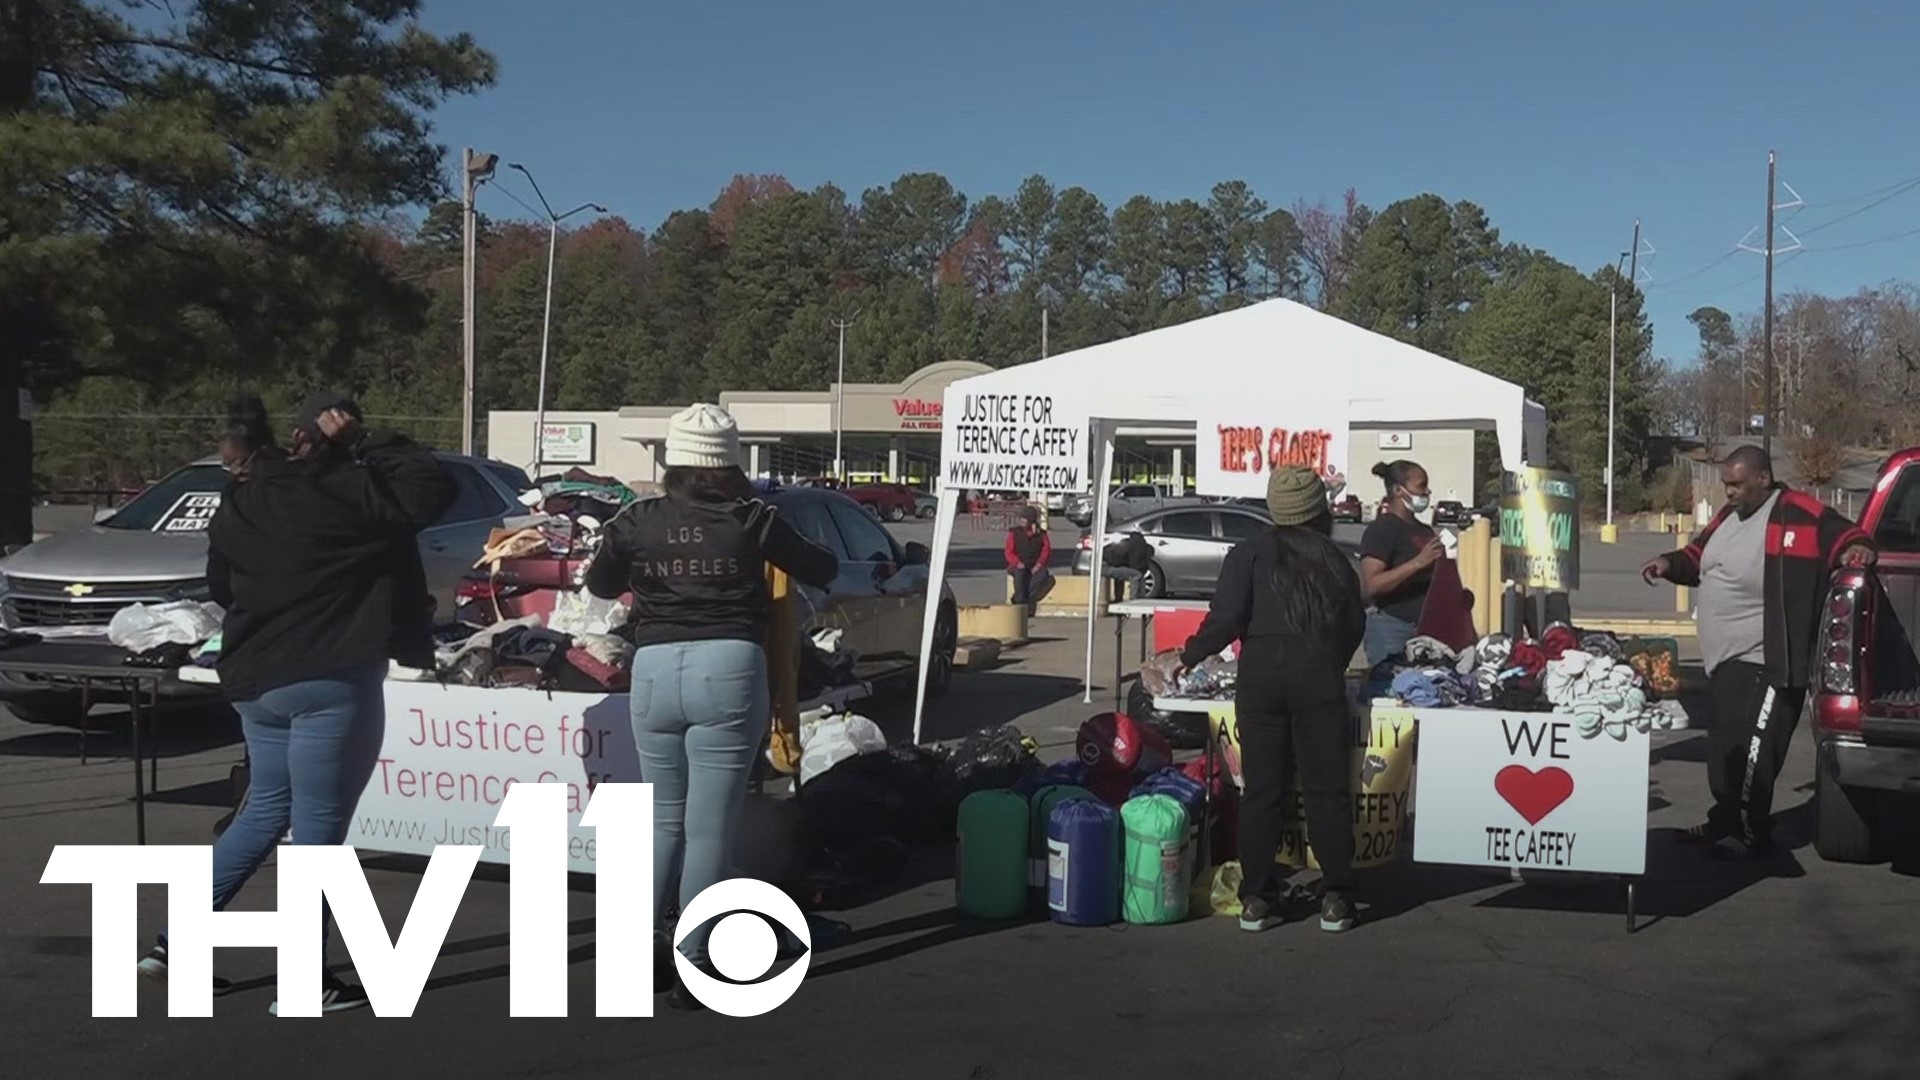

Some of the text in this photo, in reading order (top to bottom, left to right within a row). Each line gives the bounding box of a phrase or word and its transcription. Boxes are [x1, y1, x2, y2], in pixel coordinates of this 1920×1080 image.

[892, 399, 943, 416] Value
[961, 394, 1052, 424] JUSTICE FOR
[956, 425, 1078, 456] TERENCE CAFFEY
[949, 460, 1078, 490] WWW.JUSTICE4TEE.COM
[667, 527, 703, 544] LOS
[643, 558, 738, 577] ANGELES
[408, 707, 612, 760] Justice for
[1501, 718, 1571, 759] WE
[1485, 826, 1577, 867] TEE CAFFEY
